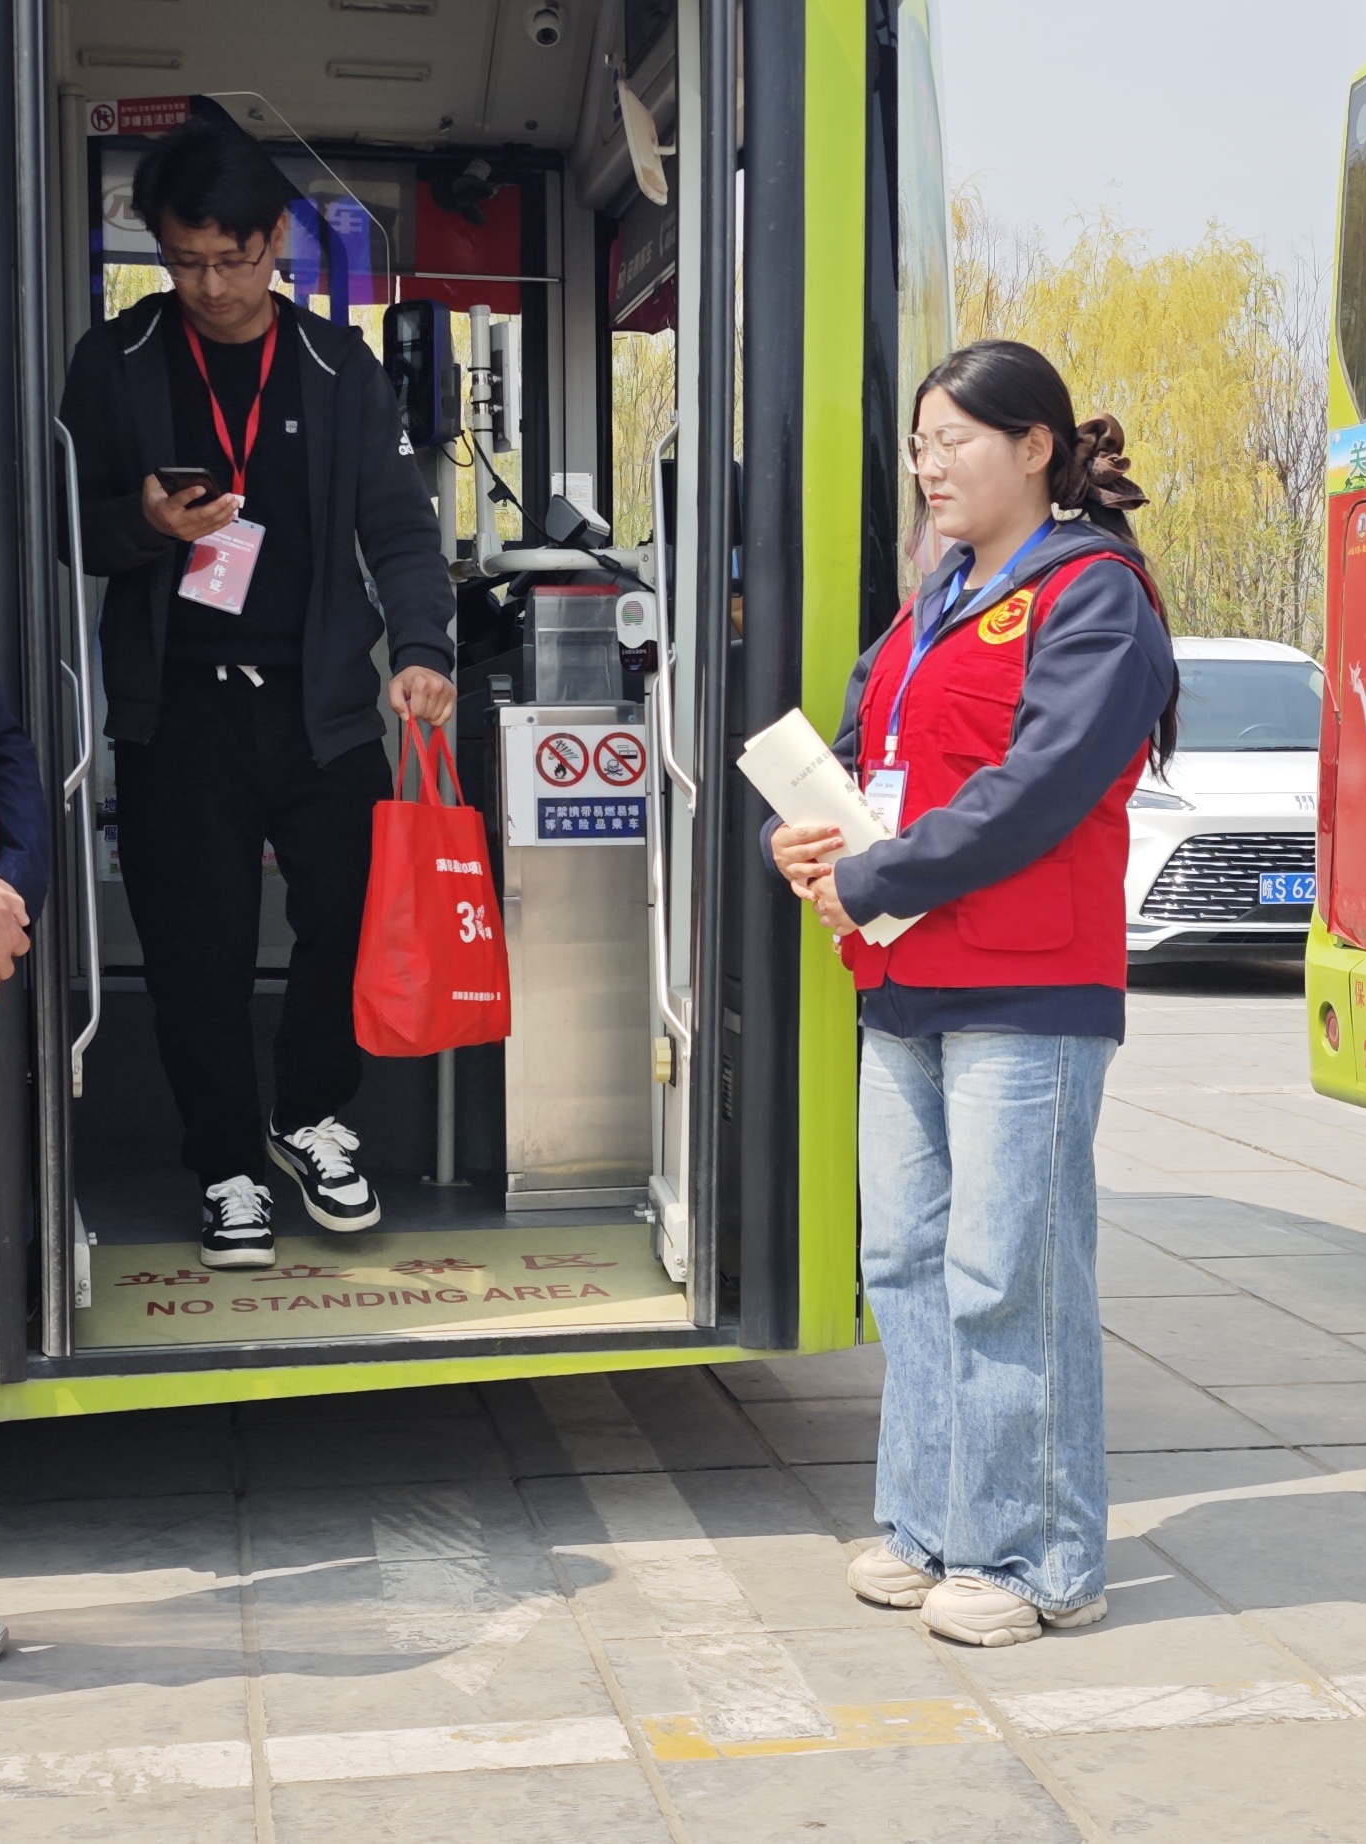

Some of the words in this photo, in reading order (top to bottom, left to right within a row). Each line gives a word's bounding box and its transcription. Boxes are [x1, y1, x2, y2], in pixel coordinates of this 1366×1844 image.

[545, 805, 640, 818] 严禁携带易燃易爆
[545, 818, 640, 831] 等危险品乘车
[114, 1253, 619, 1287] 站立禁区
[146, 1300, 215, 1317] NO
[230, 1288, 470, 1313] STANDING
[482, 1283, 611, 1303] AREA
